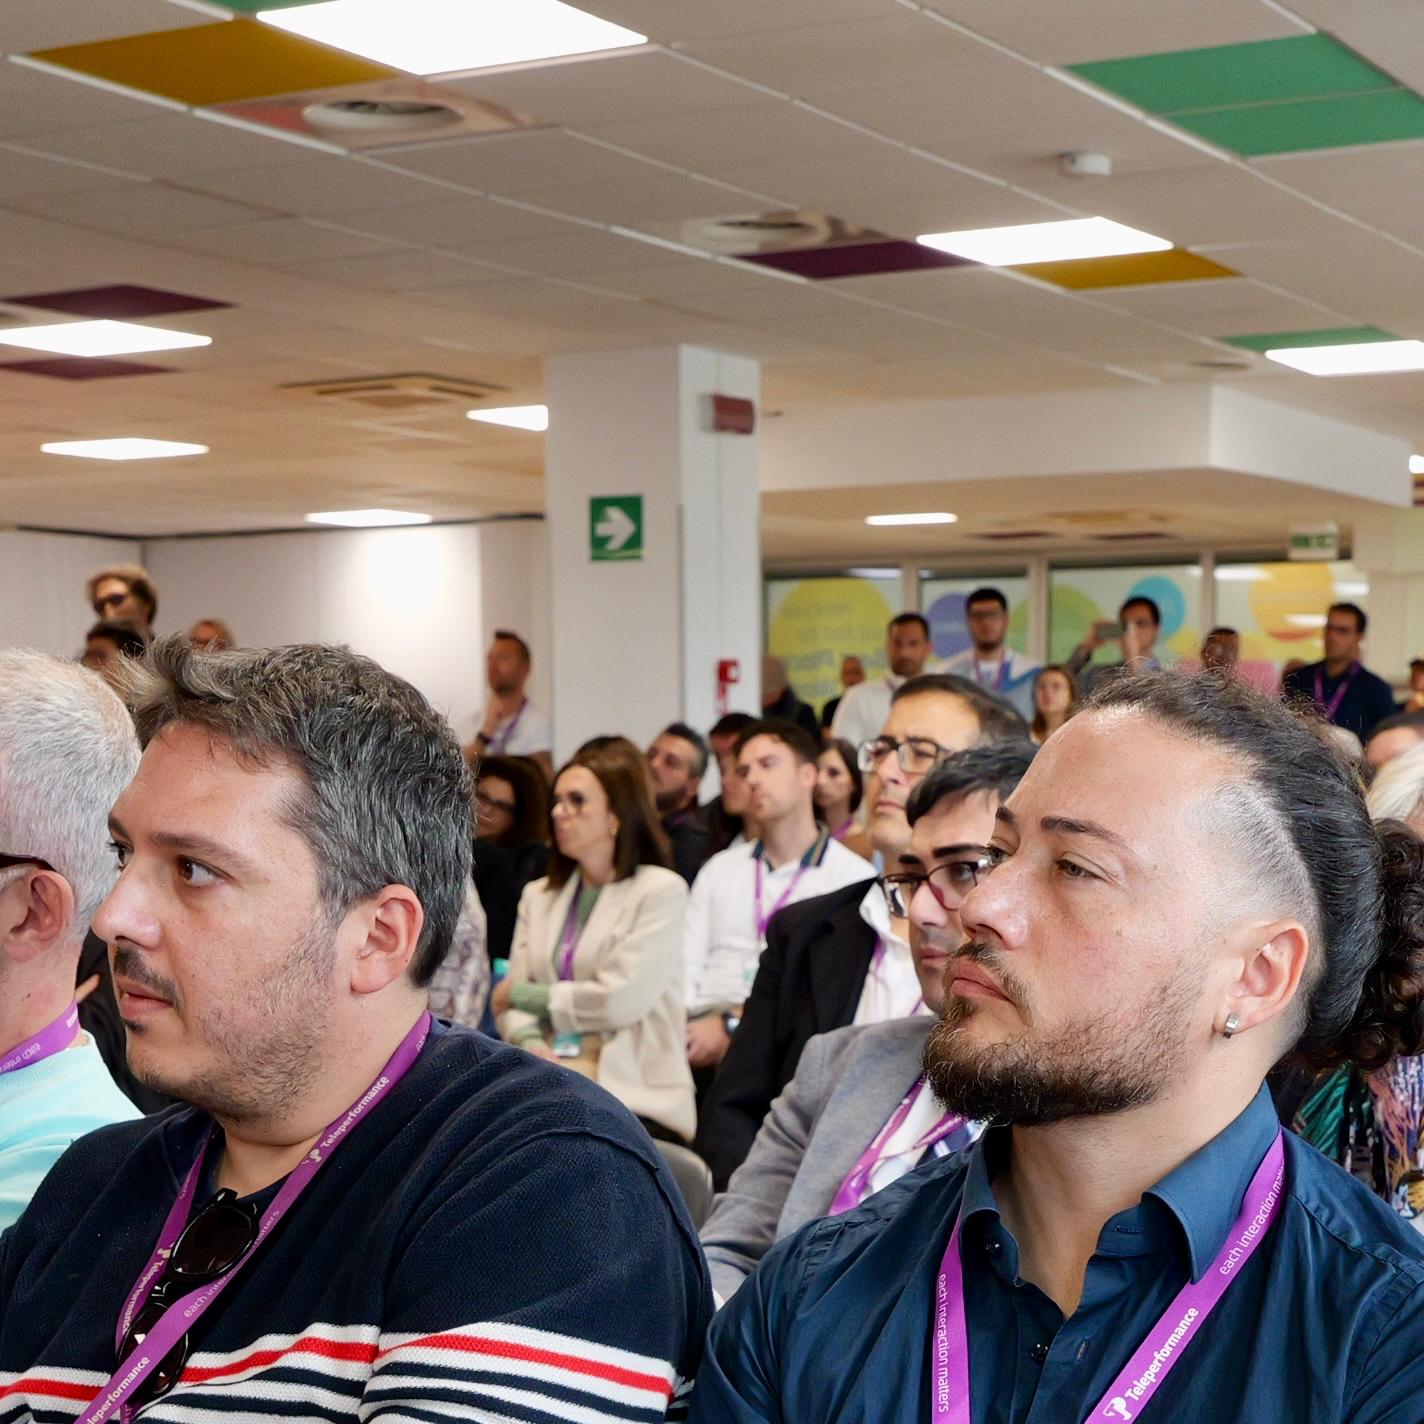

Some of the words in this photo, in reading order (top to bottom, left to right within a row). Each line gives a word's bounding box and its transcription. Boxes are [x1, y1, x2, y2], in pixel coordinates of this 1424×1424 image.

[320, 1076, 390, 1148] Teleperformance
[1219, 1247, 1244, 1276] each
[1238, 1191, 1278, 1249] interaction
[183, 1294, 208, 1319] each
[938, 1273, 949, 1302] each
[937, 1303, 951, 1366] interaction
[1124, 1307, 1200, 1401] Teleperformance
[938, 1368, 951, 1413] matters
